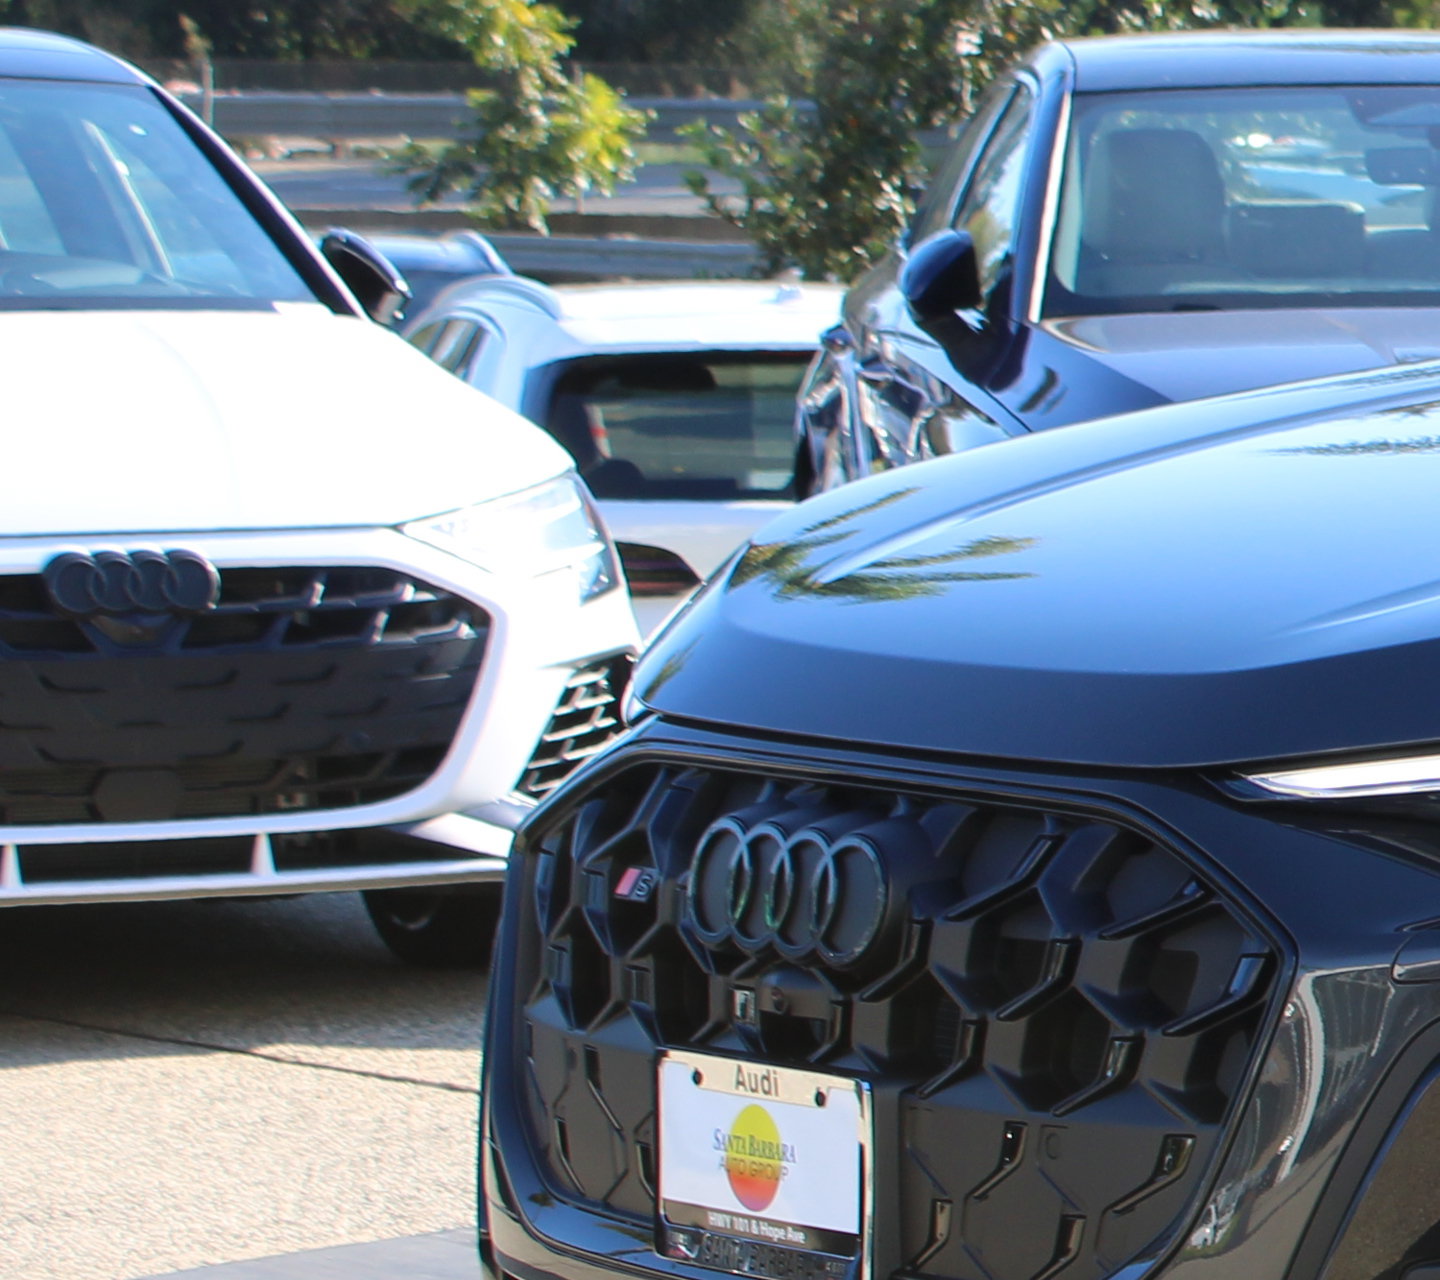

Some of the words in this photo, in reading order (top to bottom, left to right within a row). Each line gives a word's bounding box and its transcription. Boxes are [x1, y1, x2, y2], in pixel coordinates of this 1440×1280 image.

[635, 873, 653, 898] S
[735, 1064, 779, 1097] Audi
[713, 1128, 747, 1155] SANTA
[748, 1135, 796, 1164] BARBARA
[719, 1155, 746, 1176] AUTO
[748, 1160, 789, 1181] GROUP
[707, 1211, 732, 1229] HWY
[751, 1221, 760, 1235] &
[760, 1221, 786, 1242] Hope
[787, 1227, 806, 1244] Ave
